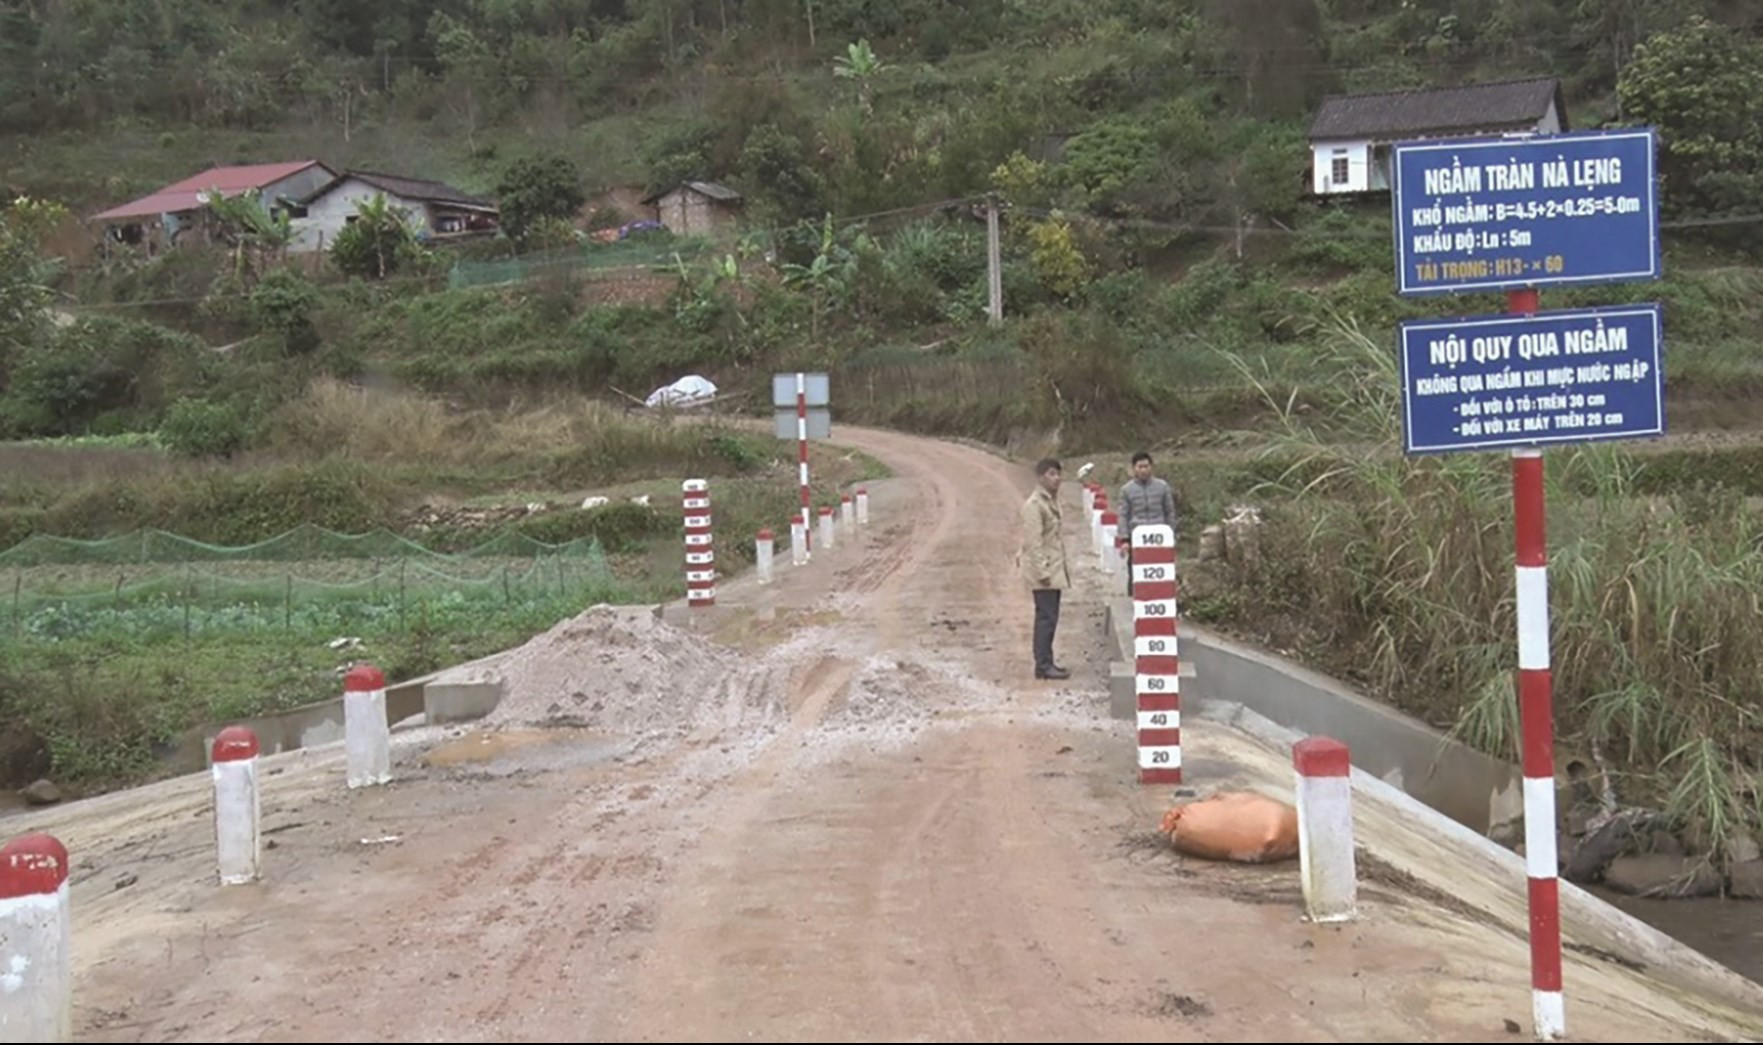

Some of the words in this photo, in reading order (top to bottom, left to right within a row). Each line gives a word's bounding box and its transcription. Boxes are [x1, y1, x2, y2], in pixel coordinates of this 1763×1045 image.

[1424, 154, 1482, 195] NGẦM
[1485, 157, 1535, 191] TRÀN
[1542, 154, 1569, 188] NÀ
[1573, 157, 1622, 191] LẸNG
[1412, 197, 1442, 226] KHỔ
[1509, 230, 1532, 247] 5m
[1429, 333, 1467, 369] NỘI
[1472, 336, 1512, 364] QUY
[1518, 332, 1559, 360] QUA
[1564, 318, 1628, 355] NGẦM
[1416, 373, 1458, 396] KHÔNG
[1459, 374, 1483, 394] QUA
[1523, 370, 1544, 387] KHI
[1613, 358, 1649, 383] NGẬP
[1536, 392, 1567, 410] TRÊN
[1569, 394, 1584, 408] 30
[1587, 394, 1606, 406] cm
[1505, 418, 1521, 432] XE
[1523, 413, 1550, 431] MÁY
[1554, 410, 1585, 429] TRÊN
[1587, 412, 1602, 426] 20
[1604, 413, 1624, 425] cm
[1142, 533, 1164, 545] 140
[1143, 567, 1165, 579] 120
[1144, 603, 1166, 615] 100
[1148, 678, 1165, 690] 60
[1150, 713, 1167, 725] 40
[1152, 751, 1169, 763] 20
